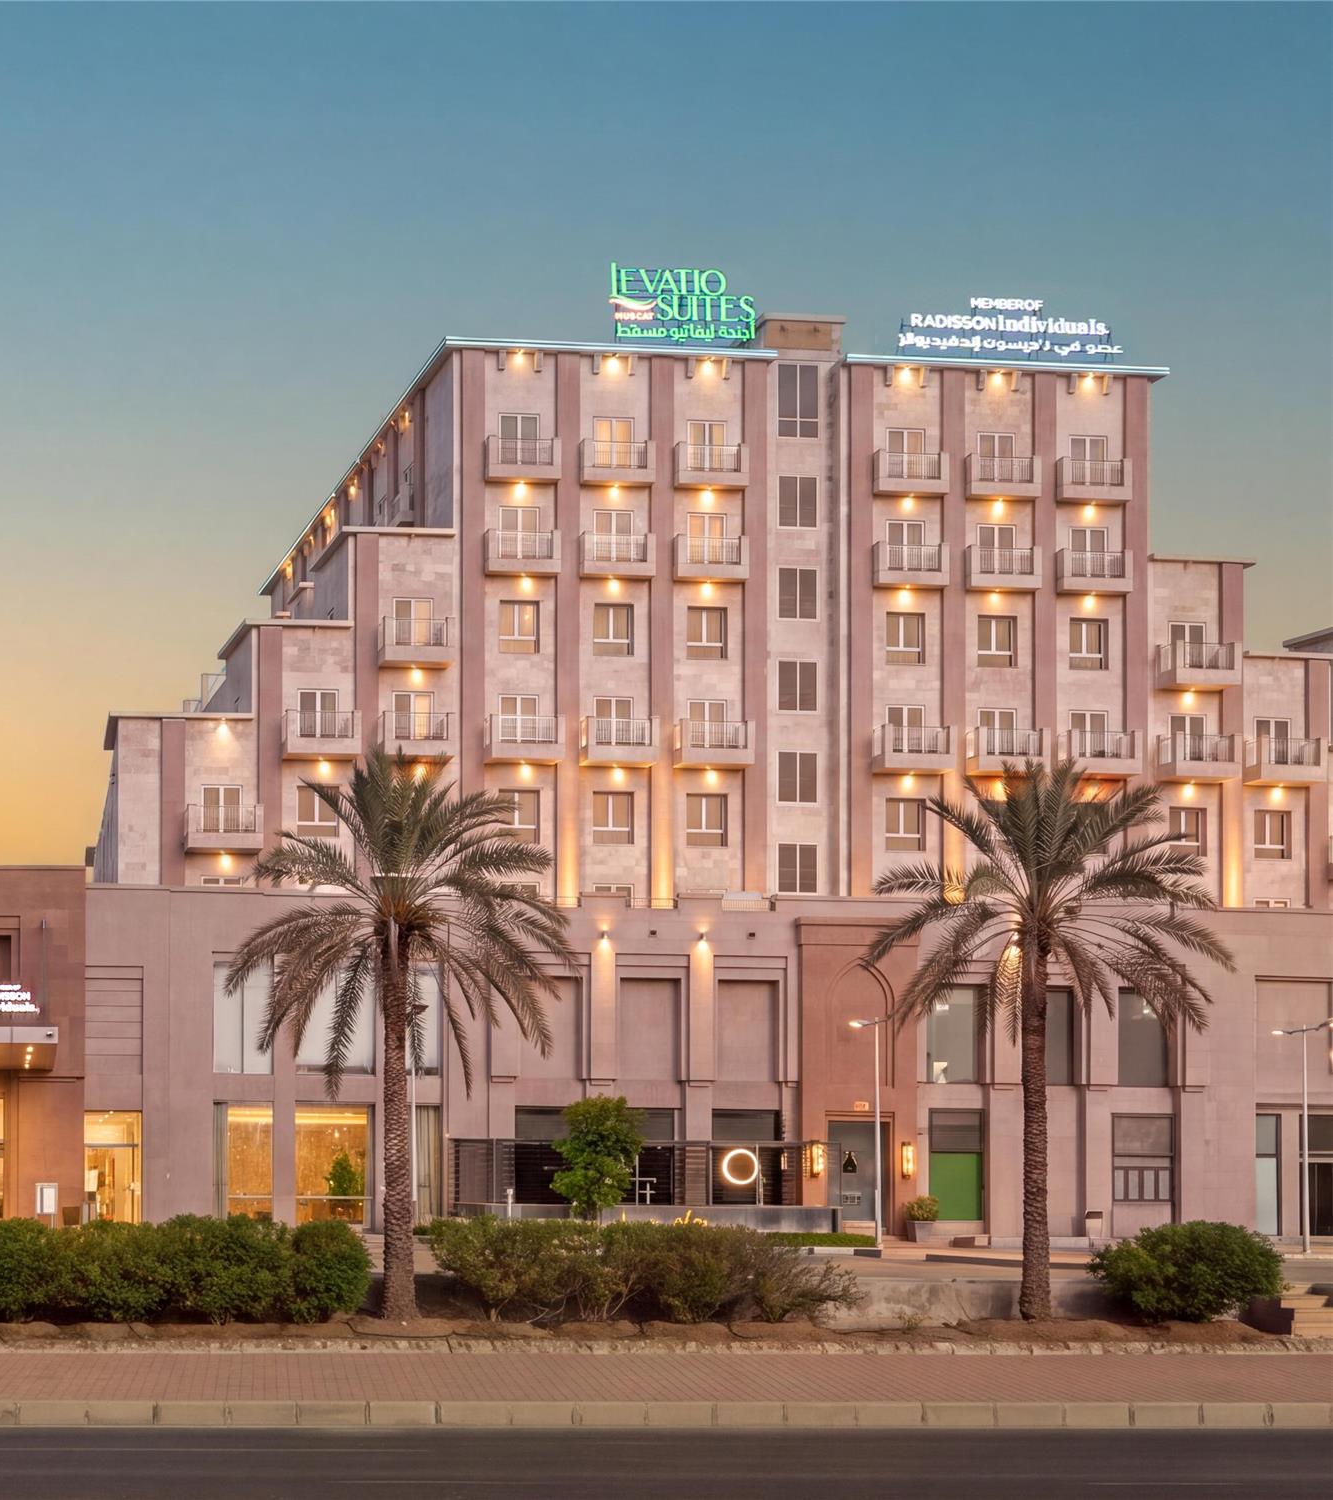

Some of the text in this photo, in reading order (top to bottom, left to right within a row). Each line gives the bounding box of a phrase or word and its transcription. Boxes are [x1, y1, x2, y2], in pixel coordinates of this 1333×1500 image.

[610, 262, 727, 299] LEVATIO
[656, 294, 756, 322] SUITES
[616, 322, 668, 338] مسقط
[910, 313, 997, 331] RADISSON
